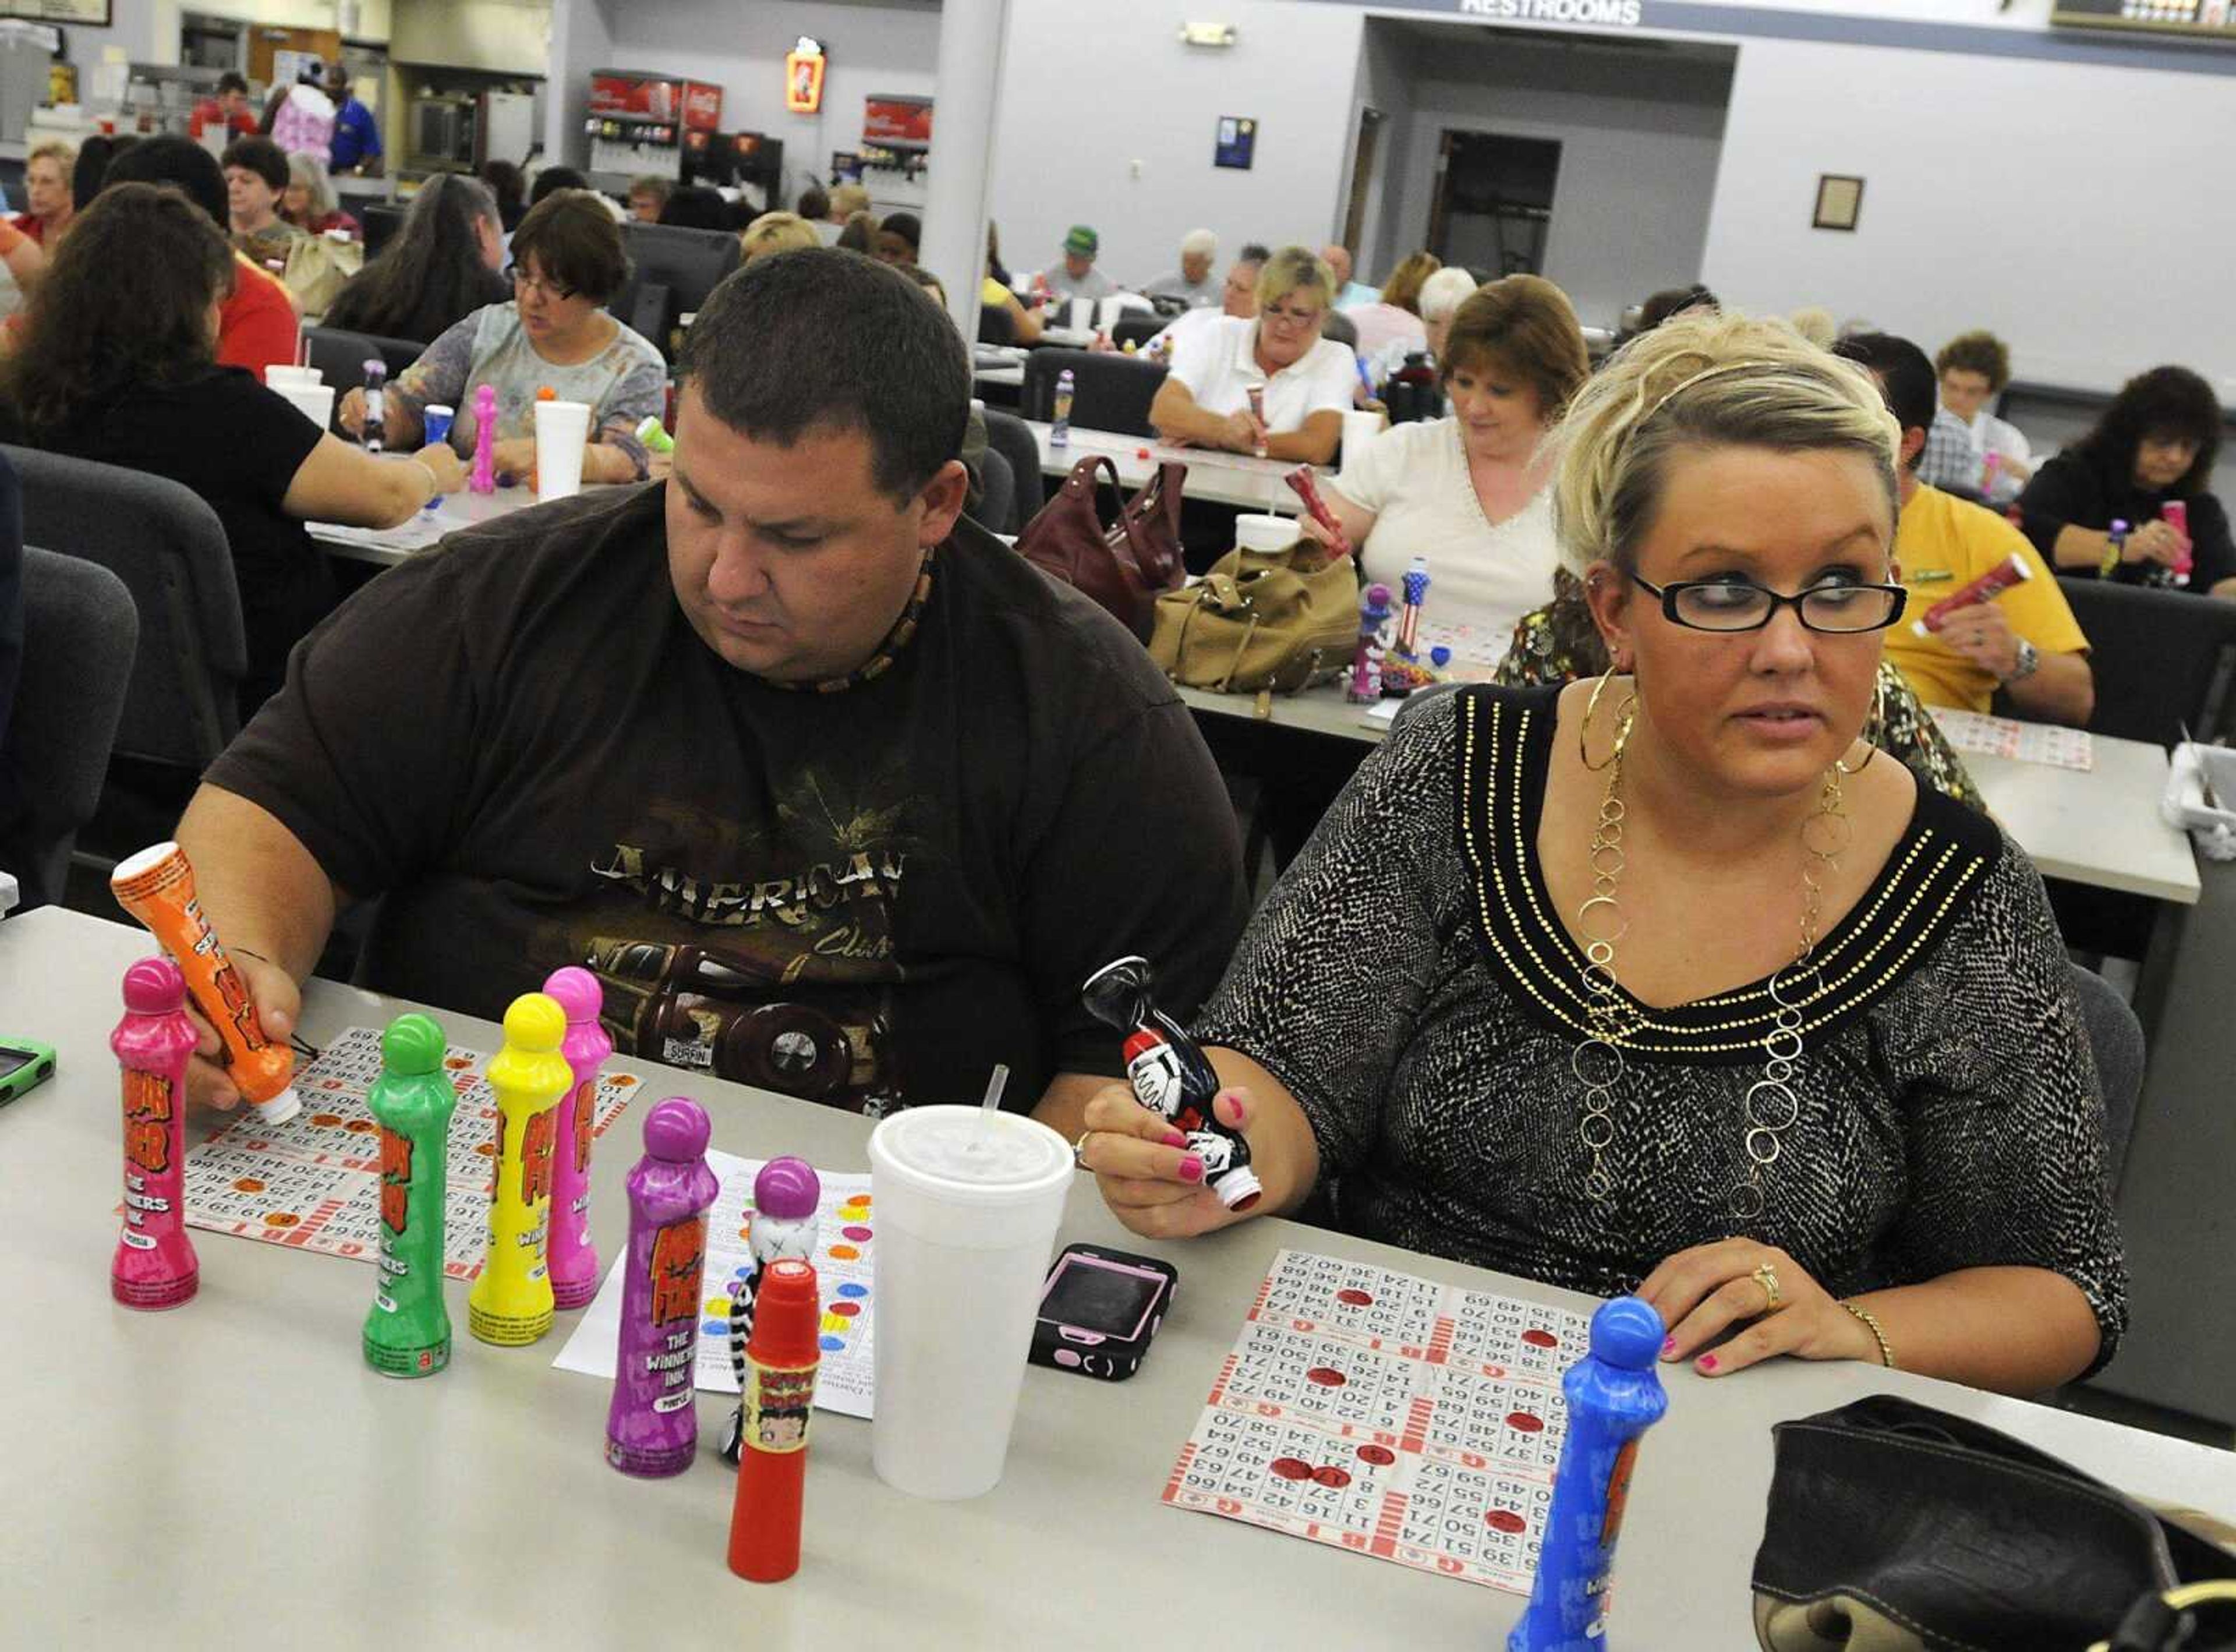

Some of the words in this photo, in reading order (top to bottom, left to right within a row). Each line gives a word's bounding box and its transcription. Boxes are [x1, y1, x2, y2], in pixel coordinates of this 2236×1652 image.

[1287, 1253, 1310, 1265] 72
[1282, 1265, 1307, 1276] 68
[1317, 1261, 1343, 1271] 60
[1314, 1272, 1338, 1284] 56
[1351, 1268, 1374, 1278] 36
[1277, 1276, 1302, 1288] 64
[1384, 1274, 1409, 1286] 24
[1271, 1289, 1298, 1300] 67
[1418, 1283, 1438, 1295] 11
[1266, 1300, 1291, 1312] 74
[1375, 1299, 1400, 1311] 29
[1411, 1296, 1434, 1307] 15
[1464, 1295, 1490, 1306] 69
[1497, 1301, 1522, 1312] 49
[1298, 1307, 1323, 1319] 53
[1370, 1310, 1398, 1323] 30
[1414, 1309, 1426, 1318] 9
[1461, 1307, 1486, 1320] 70
[1494, 1314, 1520, 1325] 60
[1336, 1315, 1357, 1328] 31
[1404, 1319, 1427, 1331] 12
[667, 1331, 689, 1351] THE
[1256, 1328, 1280, 1341] 61
[1399, 1332, 1423, 1344] 13
[1248, 1341, 1275, 1353] 65
[1285, 1335, 1312, 1349] 53
[1489, 1339, 1515, 1350] 46
[1280, 1348, 1308, 1362] 50
[1321, 1343, 1344, 1356] 39
[1244, 1354, 1267, 1367] 71
[1316, 1356, 1339, 1368] 33
[1356, 1353, 1381, 1366] 19
[1486, 1352, 1512, 1364] 56
[1279, 1361, 1302, 1375] 51
[1352, 1365, 1379, 1377] 26
[1397, 1361, 1410, 1372] 2
[664, 1370, 686, 1388] INK
[1234, 1367, 1262, 1381] 73
[1386, 1374, 1410, 1386] 14
[1447, 1371, 1469, 1385] 71
[1229, 1381, 1255, 1395] 72
[1270, 1375, 1297, 1389] 55
[1478, 1382, 1506, 1394] 47
[1264, 1389, 1292, 1401] 49
[1305, 1384, 1333, 1396] 43
[1382, 1387, 1409, 1399] 12
[1442, 1386, 1468, 1400] 65
[1514, 1388, 1542, 1400] 40
[1300, 1398, 1328, 1410] 40
[1342, 1392, 1370, 1406] 20
[1475, 1396, 1502, 1409] 59
[1336, 1405, 1365, 1420] 22
[1385, 1401, 1399, 1412] 4
[1438, 1400, 1464, 1414] 68
[1213, 1414, 1241, 1428] 70
[1380, 1417, 1394, 1428] 6
[1433, 1414, 1459, 1428] 75
[1472, 1409, 1499, 1423] 58
[1207, 1428, 1236, 1443] 64
[1250, 1421, 1278, 1437] 58
[1469, 1423, 1496, 1436] 48
[1287, 1430, 1317, 1444] 34
[1432, 1430, 1457, 1443] 61
[1509, 1430, 1535, 1444] 41
[1200, 1444, 1230, 1458] 67
[1243, 1437, 1272, 1452] 52
[1325, 1440, 1354, 1455] 25
[1465, 1437, 1494, 1452] 52
[1281, 1445, 1310, 1459] 32
[1503, 1446, 1530, 1460] 37
[1236, 1452, 1265, 1466] 49
[1193, 1459, 1223, 1474] 63
[1368, 1465, 1376, 1476] 1
[1420, 1464, 1449, 1478] 67
[1229, 1468, 1259, 1481] 47
[1457, 1472, 1486, 1487] 59
[1187, 1474, 1216, 1490] 66
[1359, 1481, 1375, 1494] 8
[1416, 1478, 1444, 1494] 72
[1496, 1481, 1526, 1495] 45
[1224, 1482, 1253, 1498] 54
[1308, 1487, 1339, 1502] 27
[1453, 1488, 1483, 1503] 55
[1263, 1492, 1293, 1507] 42
[1354, 1498, 1369, 1510] 3
[1412, 1494, 1442, 1509] 66
[1494, 1496, 1523, 1511] 44
[1303, 1503, 1331, 1518] 16
[1449, 1504, 1479, 1519] 57
[1345, 1512, 1370, 1529] 11
[1410, 1509, 1437, 1527] 71
[1445, 1519, 1476, 1537] 50
[1403, 1527, 1431, 1545] 74
[1486, 1530, 1516, 1547] 35
[1445, 1537, 1472, 1555] 51
[1483, 1548, 1513, 1566] 39
